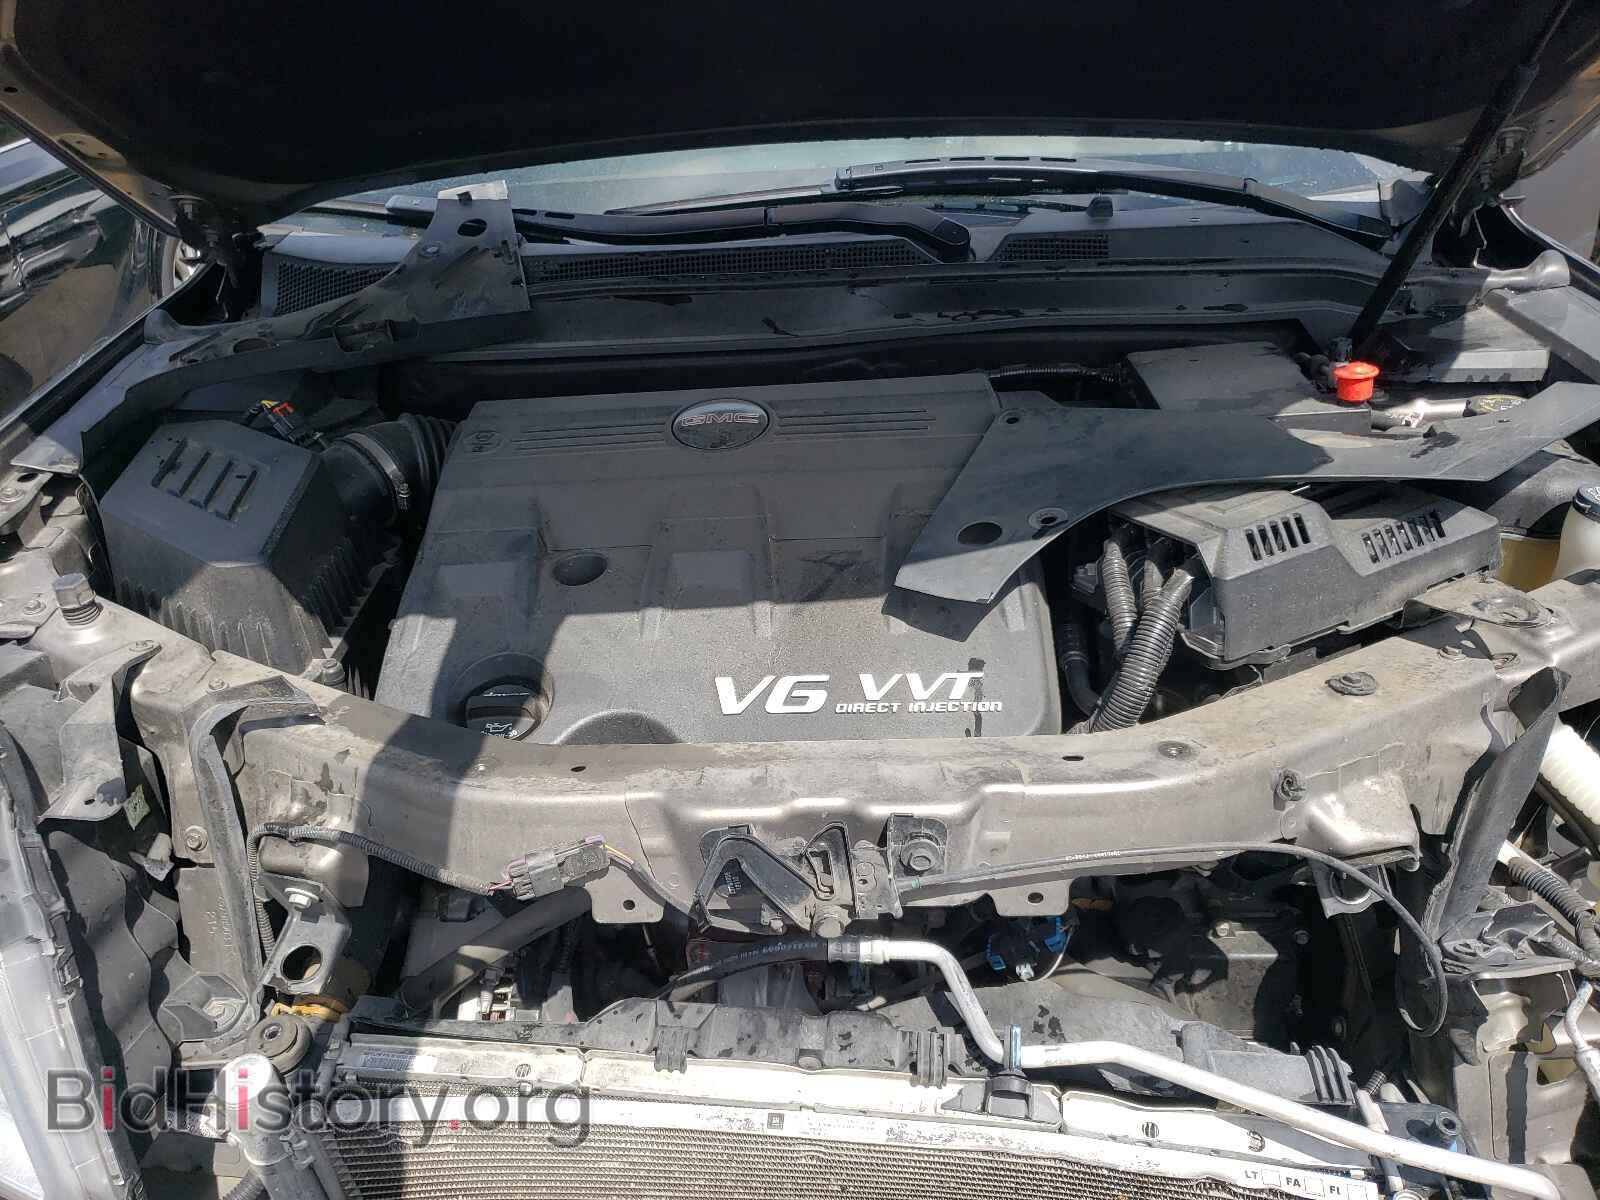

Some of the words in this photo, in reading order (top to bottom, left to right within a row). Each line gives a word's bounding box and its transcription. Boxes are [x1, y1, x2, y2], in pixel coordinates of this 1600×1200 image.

[680, 412, 760, 427] GMC
[714, 674, 830, 715] V6
[859, 672, 984, 701] VVT
[835, 702, 901, 714] DIRECT
[908, 700, 1003, 713] INJECTION
[1244, 1169, 1259, 1180] LT
[1285, 1176, 1301, 1188] FA
